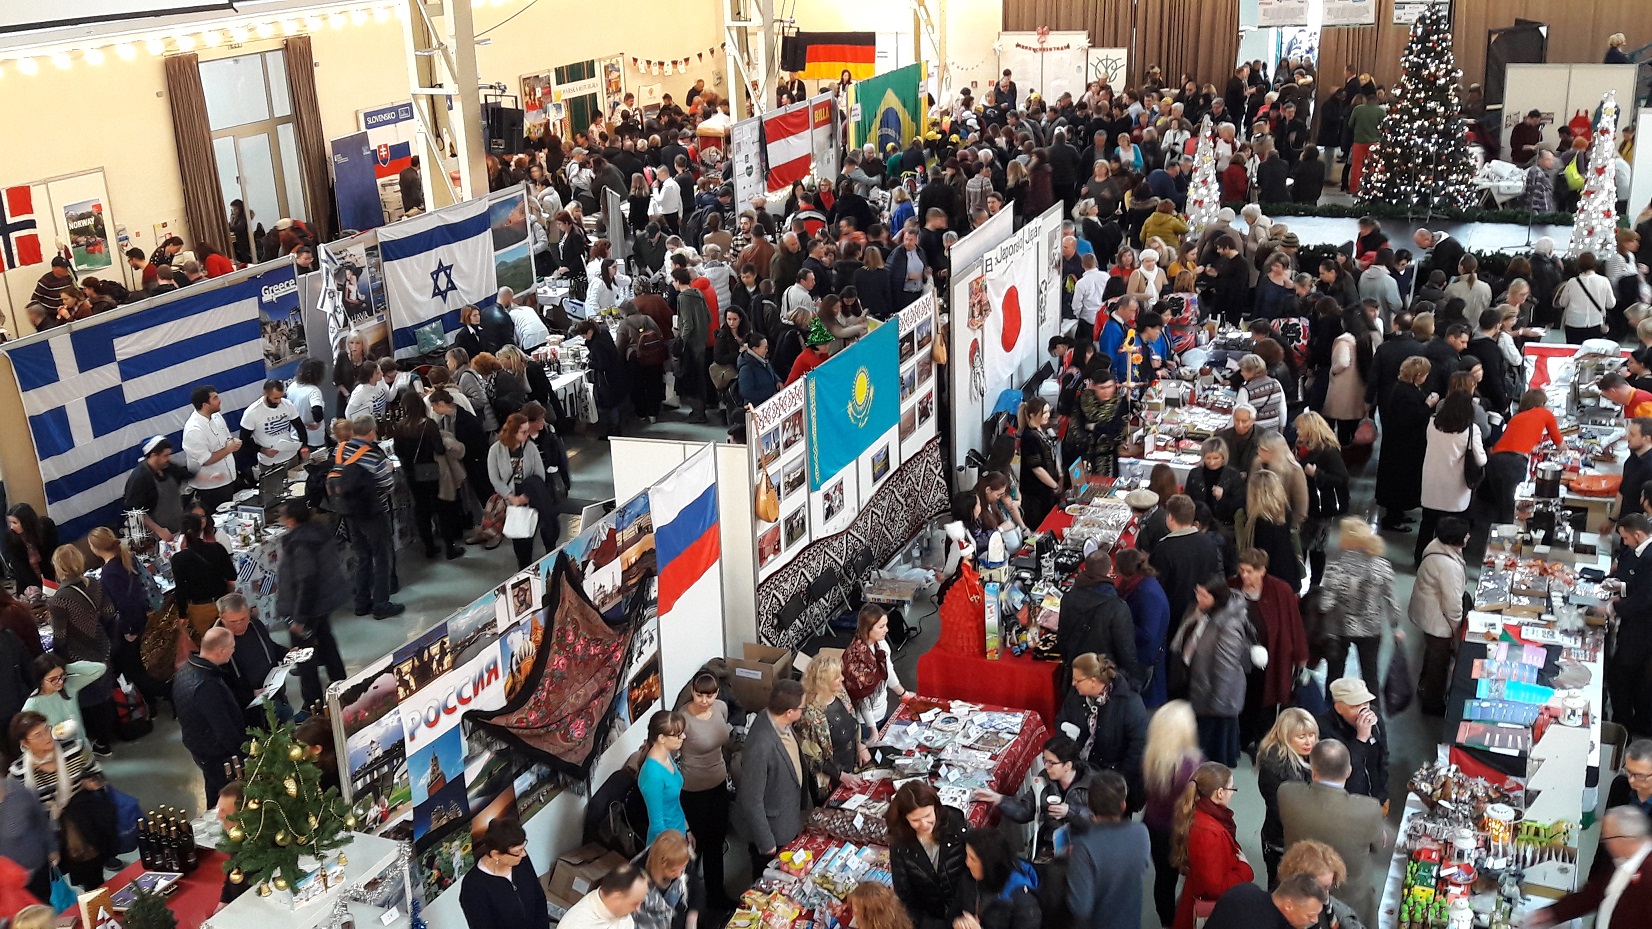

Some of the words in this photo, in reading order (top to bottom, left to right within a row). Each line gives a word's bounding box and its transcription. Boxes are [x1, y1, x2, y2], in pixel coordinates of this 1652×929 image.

[366, 111, 396, 125] SLOVENSKO
[814, 106, 830, 122] BILLA
[68, 216, 95, 230] NORWAY
[261, 278, 296, 296] Greece
[406, 655, 499, 742] РОССИЯ
